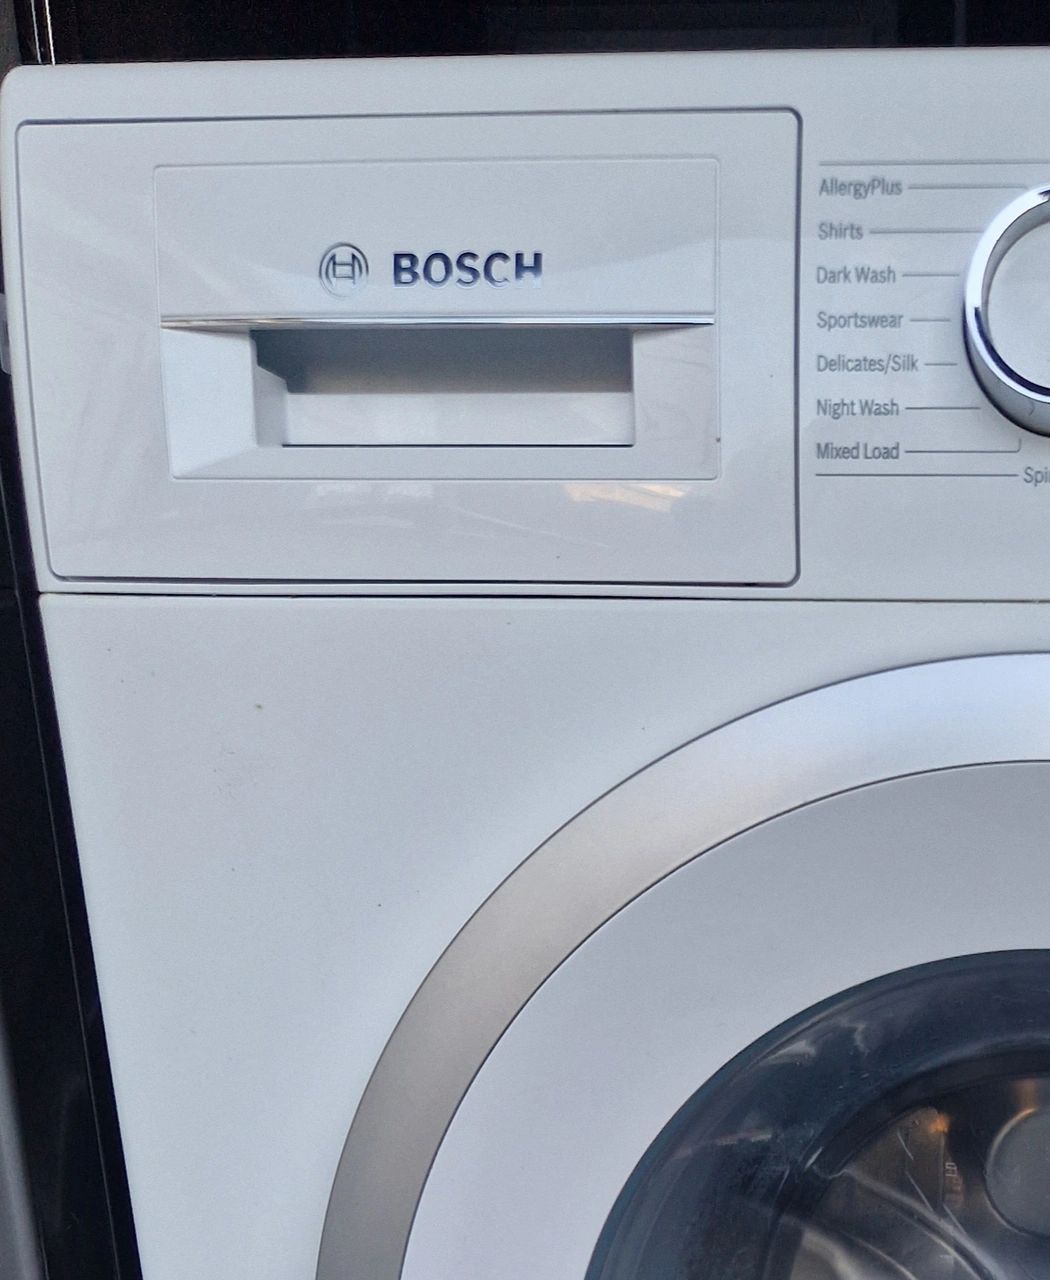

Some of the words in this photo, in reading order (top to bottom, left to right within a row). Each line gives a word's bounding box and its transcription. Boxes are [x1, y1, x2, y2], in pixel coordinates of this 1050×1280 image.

[818, 176, 903, 200] AllergyPlus
[818, 222, 863, 240] Shirts
[392, 251, 544, 289] BOSCH
[816, 265, 853, 284] Dark
[855, 265, 897, 284] Wash
[816, 311, 904, 332] Sportswear
[816, 354, 919, 375] Delicates/Silk
[816, 398, 856, 420] Night
[859, 398, 899, 417] Wash
[816, 442, 860, 460] Mixed
[863, 442, 900, 460] Load
